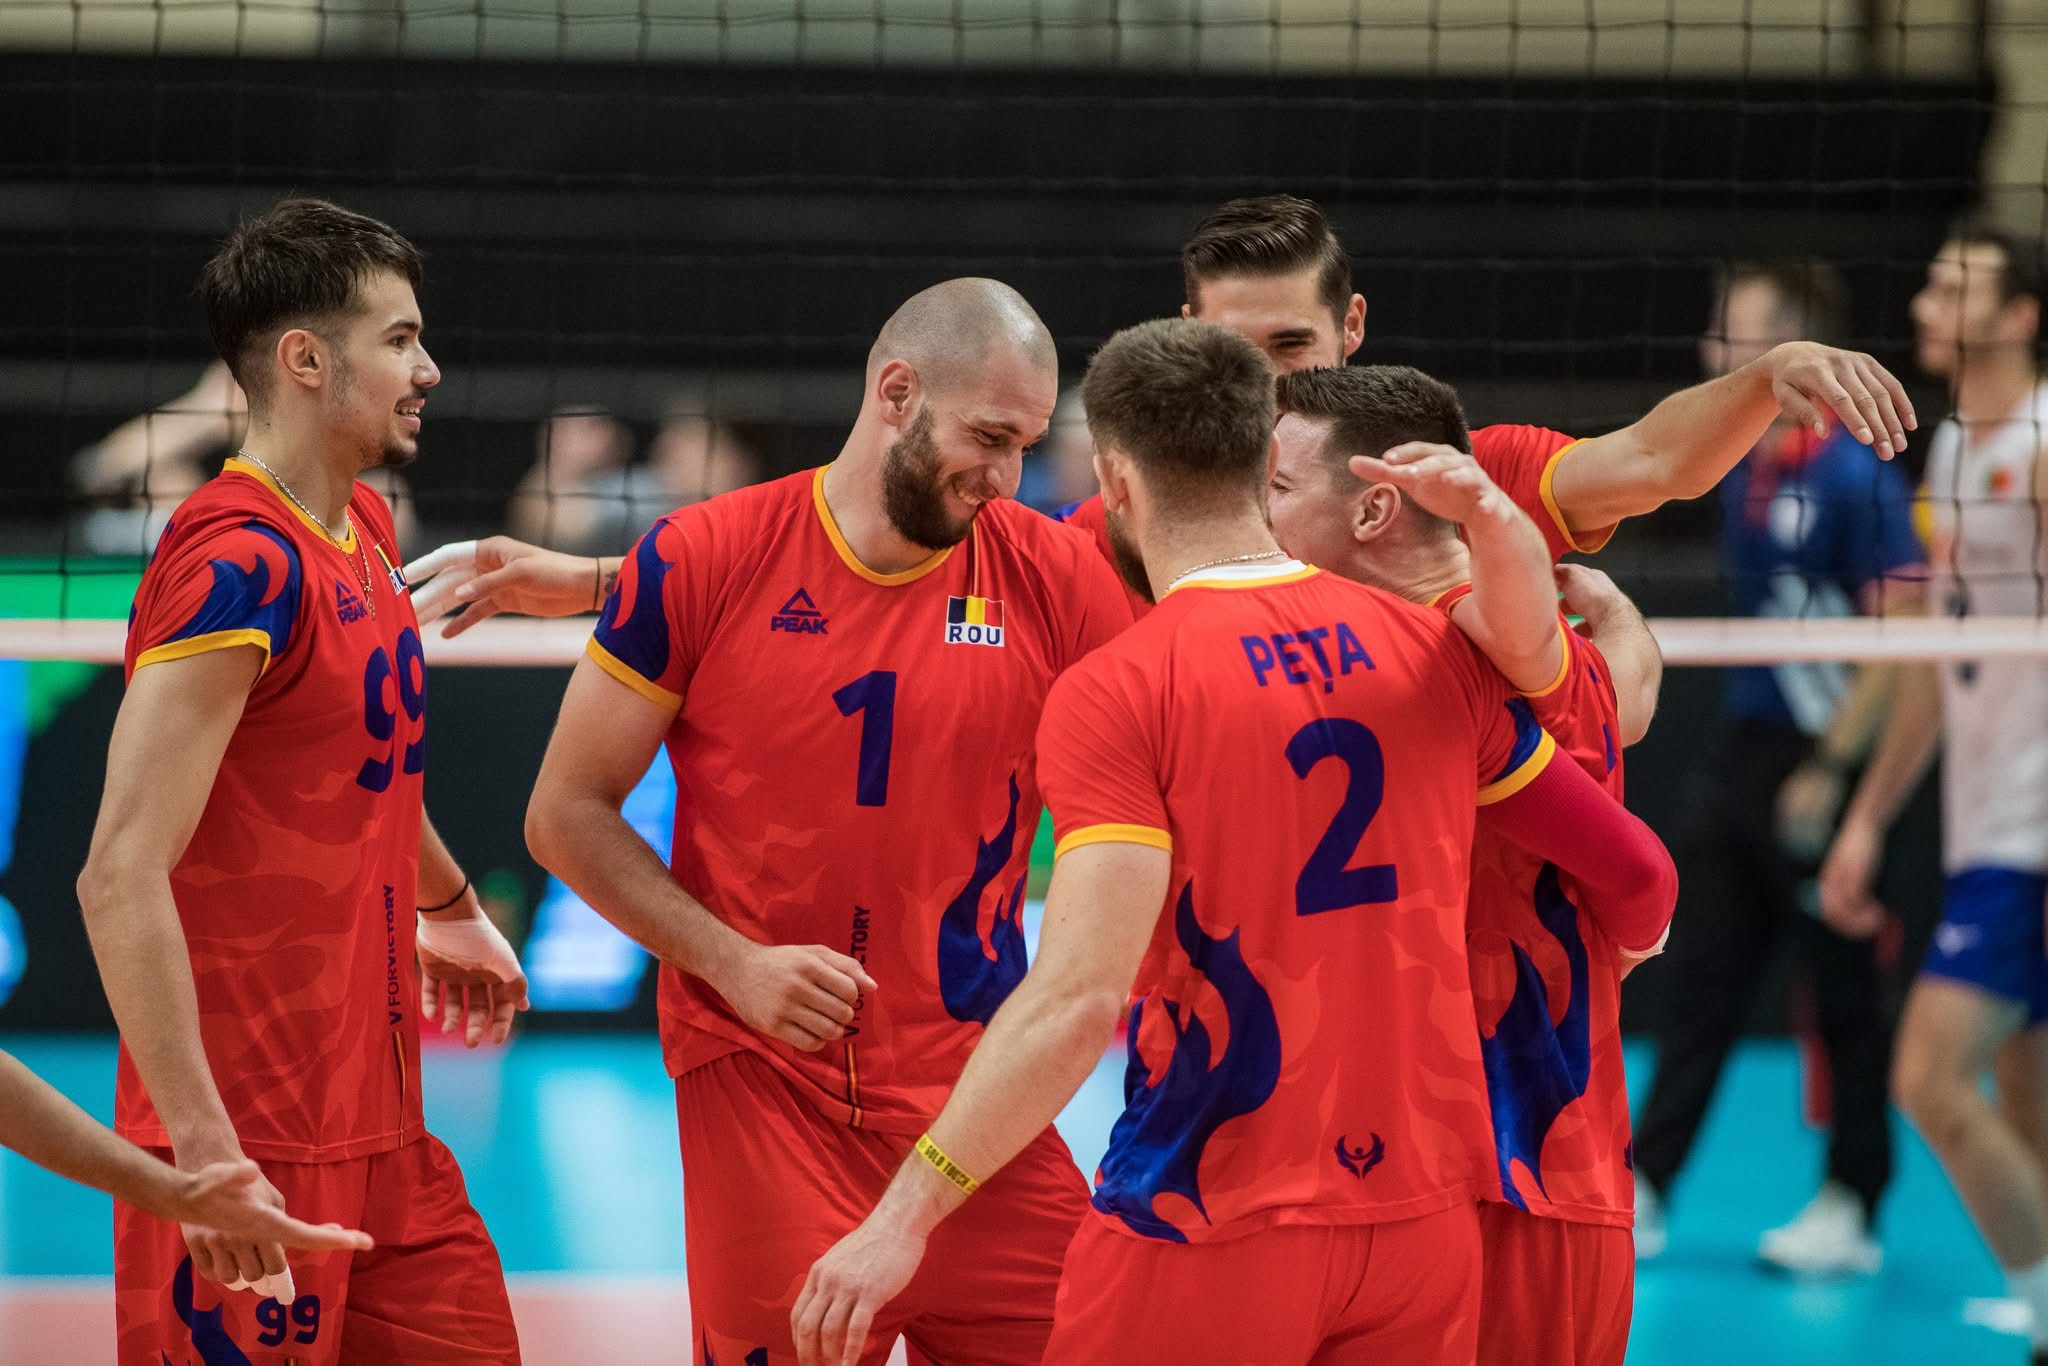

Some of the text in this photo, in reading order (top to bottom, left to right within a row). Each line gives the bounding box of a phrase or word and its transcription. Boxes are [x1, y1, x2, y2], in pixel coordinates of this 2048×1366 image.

[770, 615, 829, 635] PEAK
[948, 625, 1001, 645] ROU
[1239, 622, 1377, 694] PEȚA
[355, 625, 427, 794] 99
[832, 670, 897, 808] 1
[1284, 717, 1399, 917] 2
[255, 1294, 321, 1347] 99
